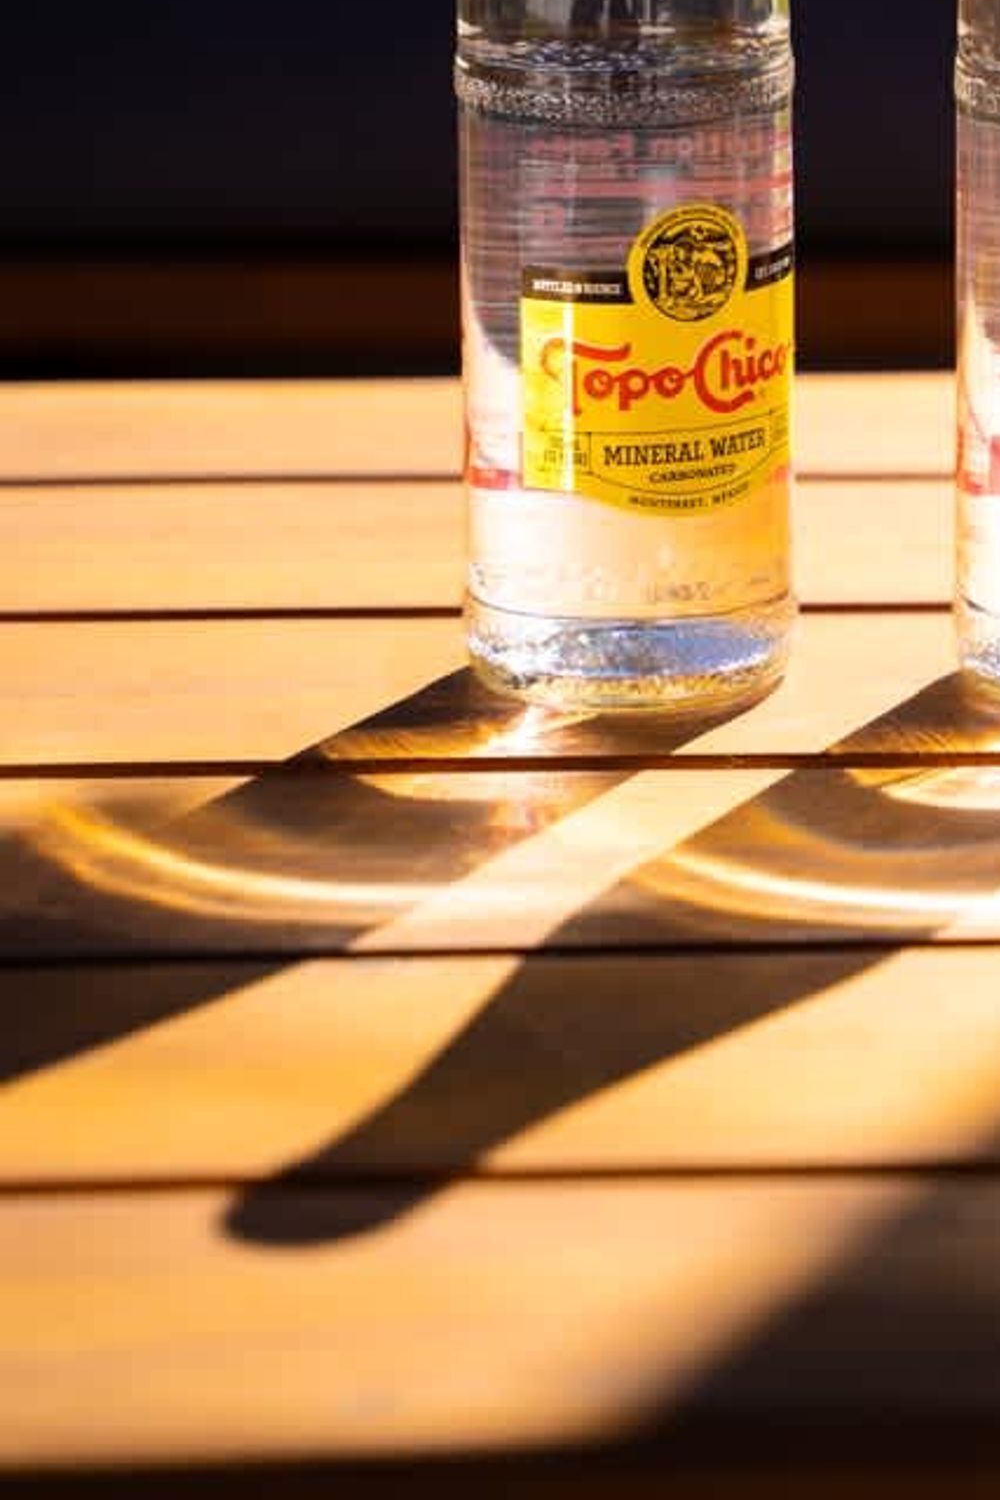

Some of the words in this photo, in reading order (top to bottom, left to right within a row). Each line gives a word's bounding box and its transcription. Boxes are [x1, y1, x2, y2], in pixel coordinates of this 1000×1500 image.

[540, 337, 690, 418] Topo
[693, 330, 789, 414] Chico
[602, 440, 704, 467] MINERAL
[709, 426, 766, 459] WATER
